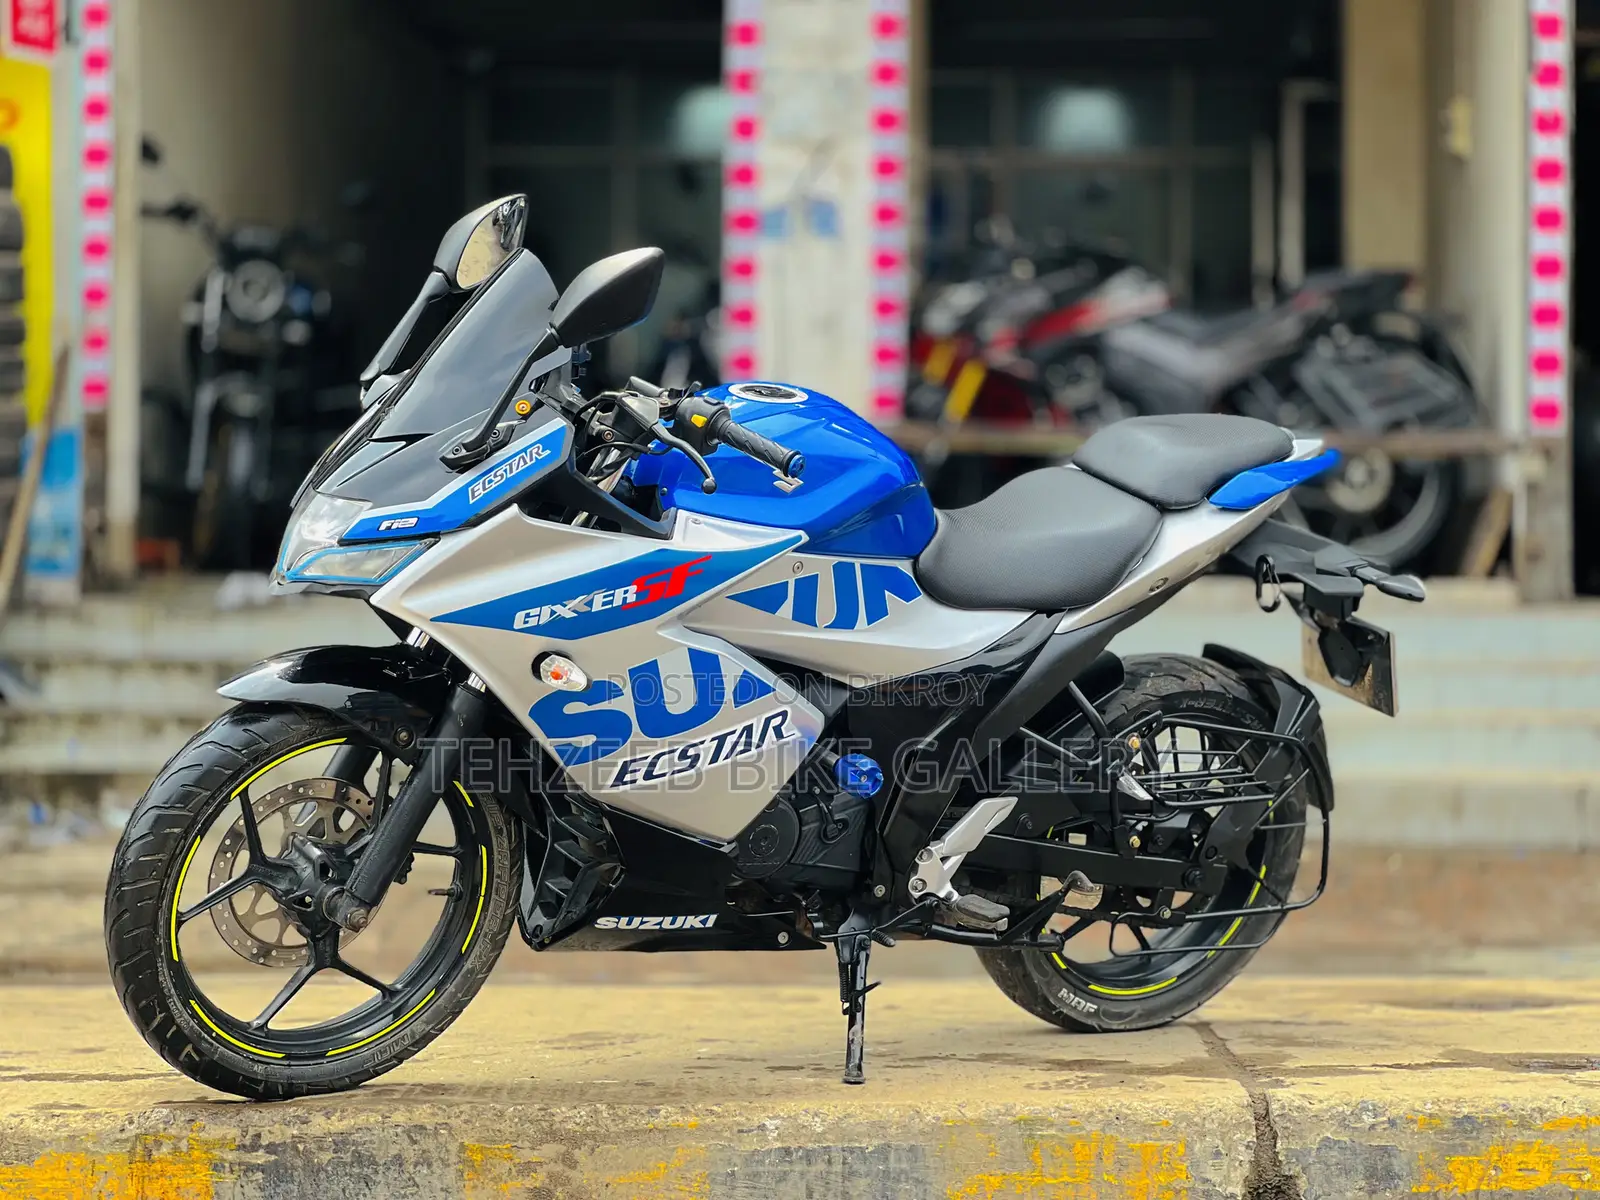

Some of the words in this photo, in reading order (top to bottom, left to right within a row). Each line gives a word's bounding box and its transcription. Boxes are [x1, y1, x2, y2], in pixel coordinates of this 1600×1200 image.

[469, 444, 550, 503] ECSTAR
[610, 709, 797, 789] ECSTAR
[594, 914, 718, 930] SUZUKI
